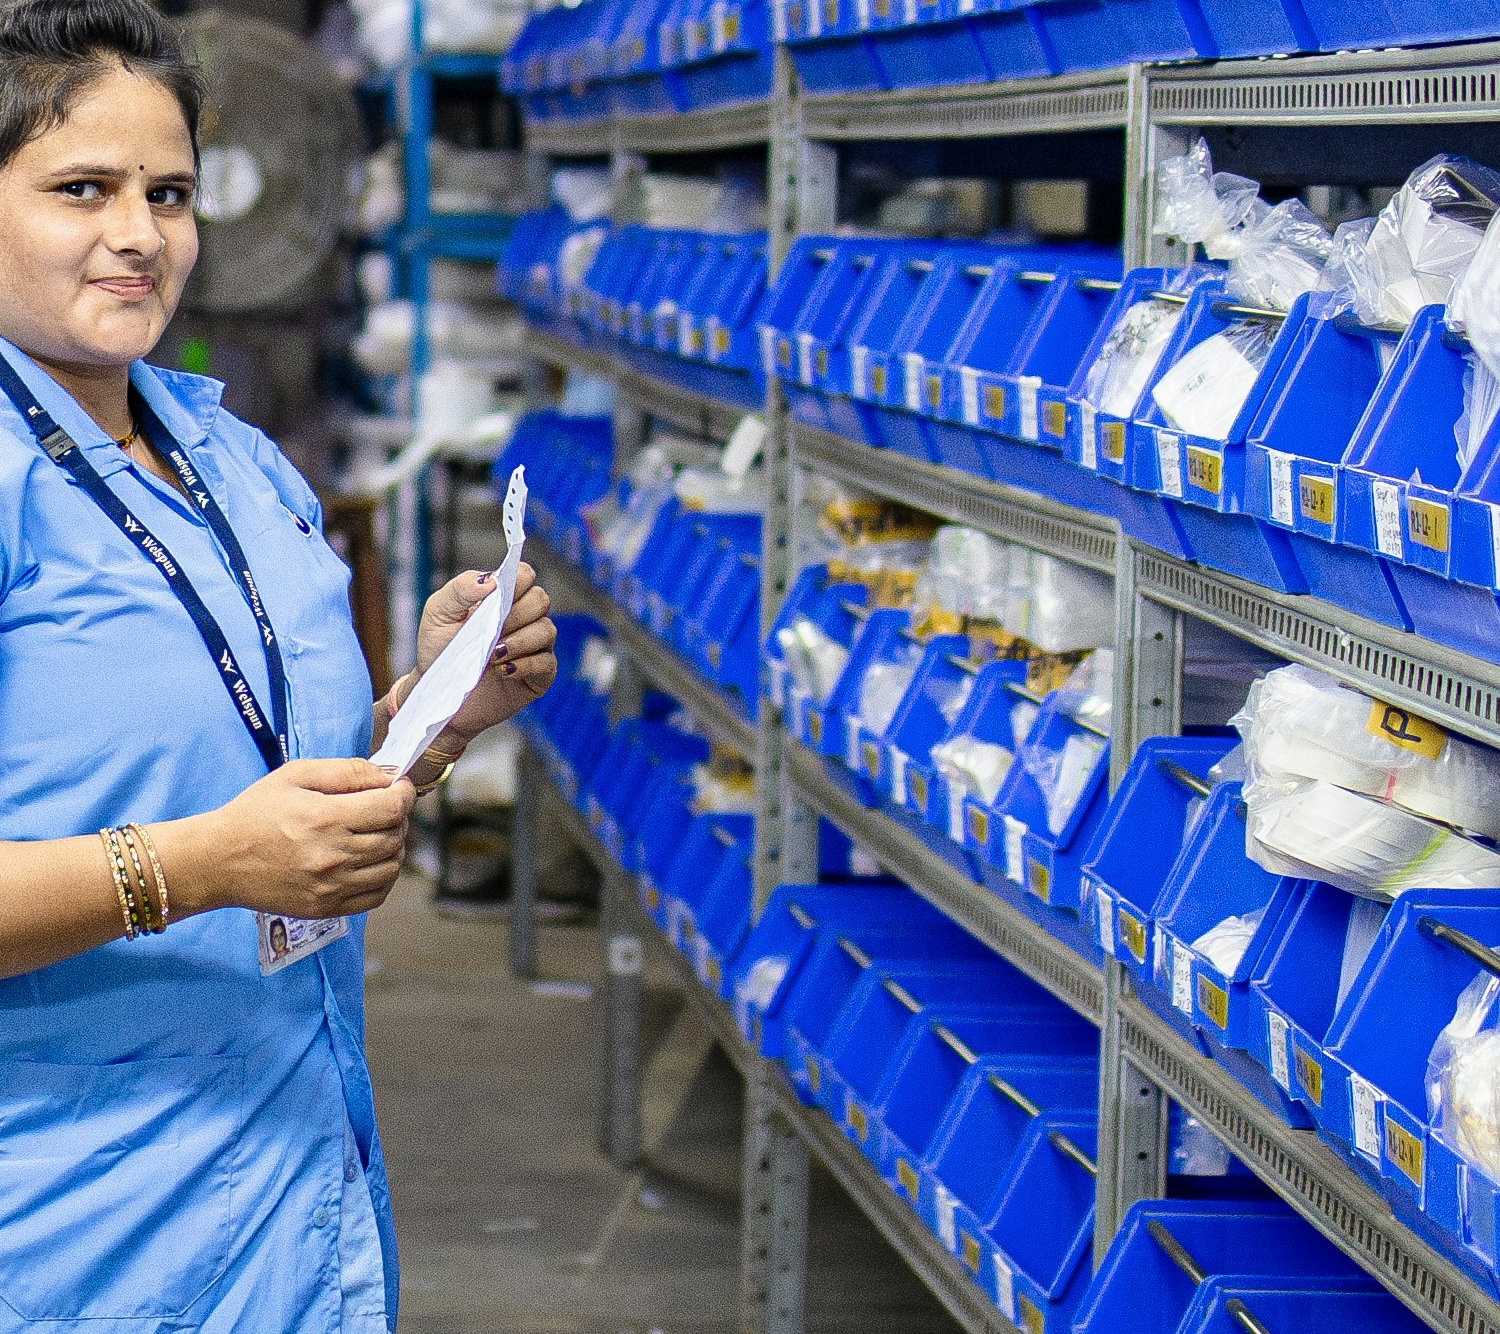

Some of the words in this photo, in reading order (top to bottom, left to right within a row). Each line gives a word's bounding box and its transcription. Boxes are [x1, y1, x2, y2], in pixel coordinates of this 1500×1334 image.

[170, 450, 196, 487] Welspun
[141, 534, 177, 578] Welspun
[232, 678, 263, 731] Welspun
